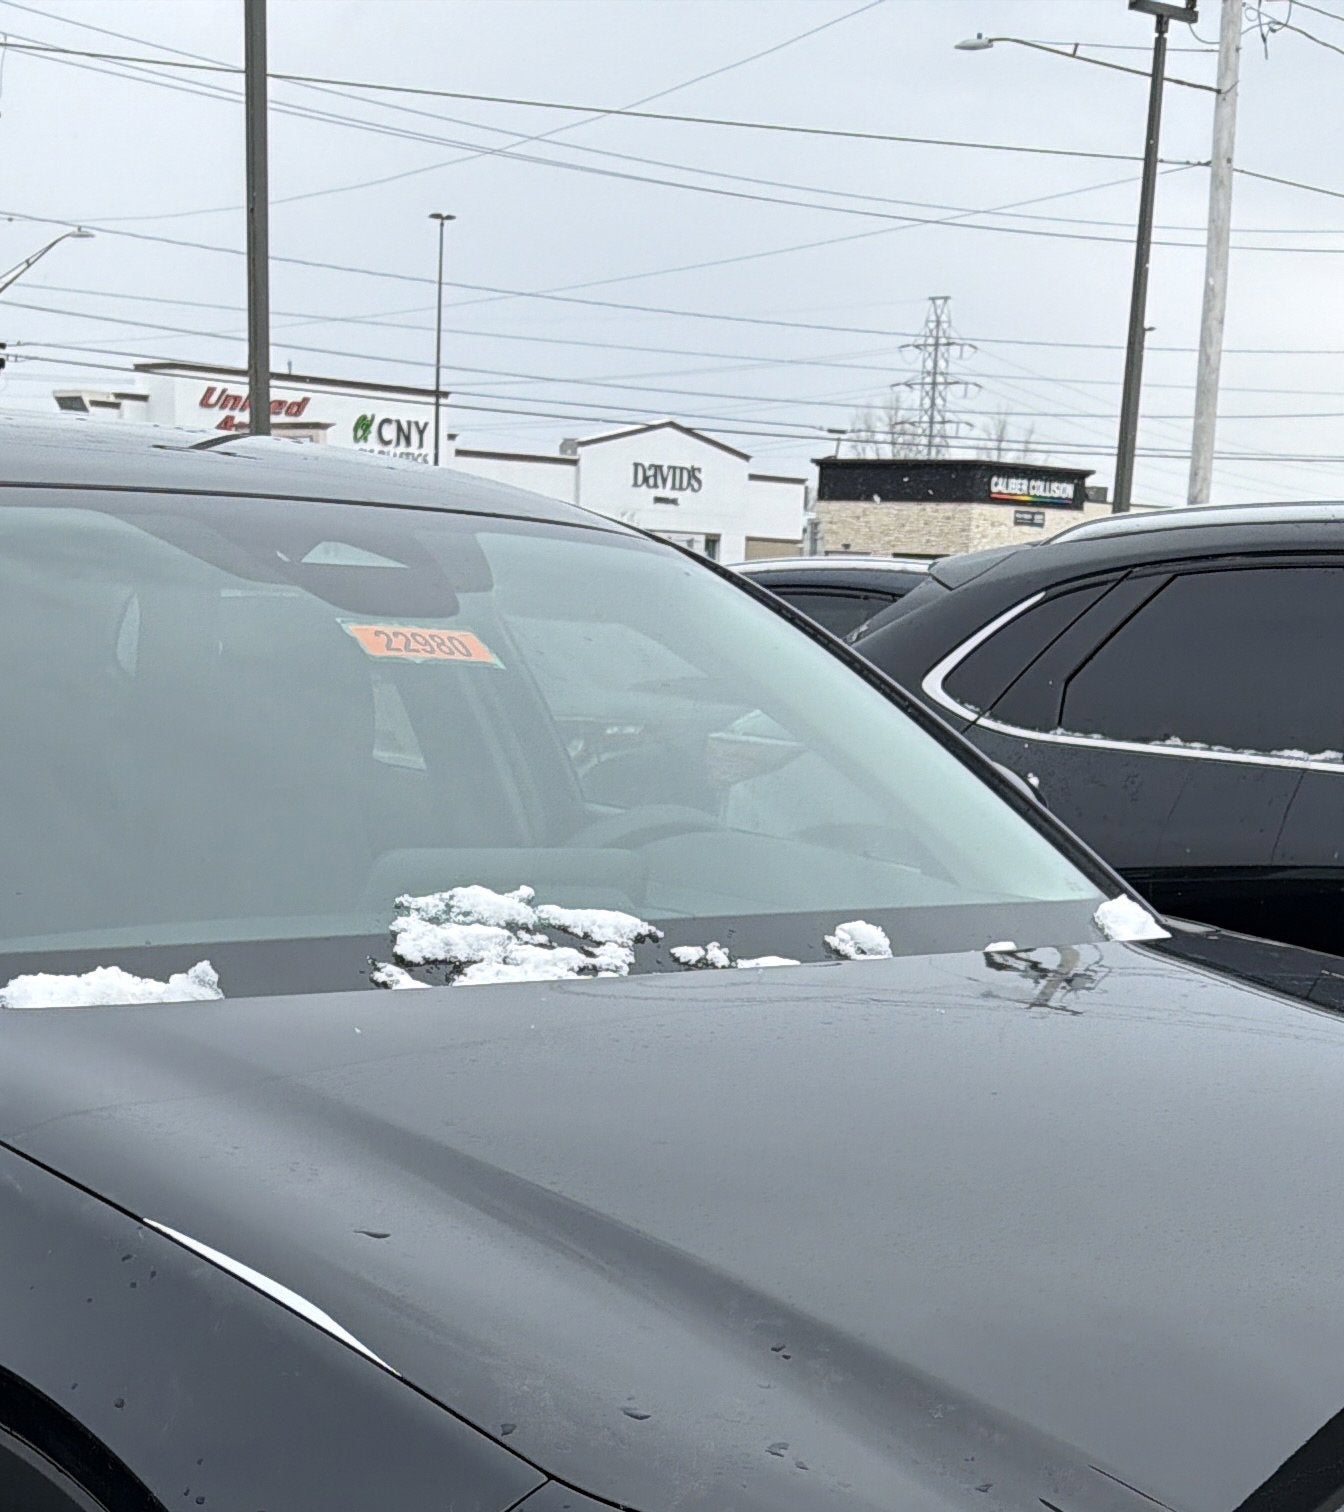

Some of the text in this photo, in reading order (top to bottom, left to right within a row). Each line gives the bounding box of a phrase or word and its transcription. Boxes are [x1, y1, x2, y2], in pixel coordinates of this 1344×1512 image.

[199, 387, 311, 417] Unied
[377, 418, 429, 448] CNY
[991, 476, 1074, 499] CALIBER COLLISION
[374, 630, 472, 657] 22980
